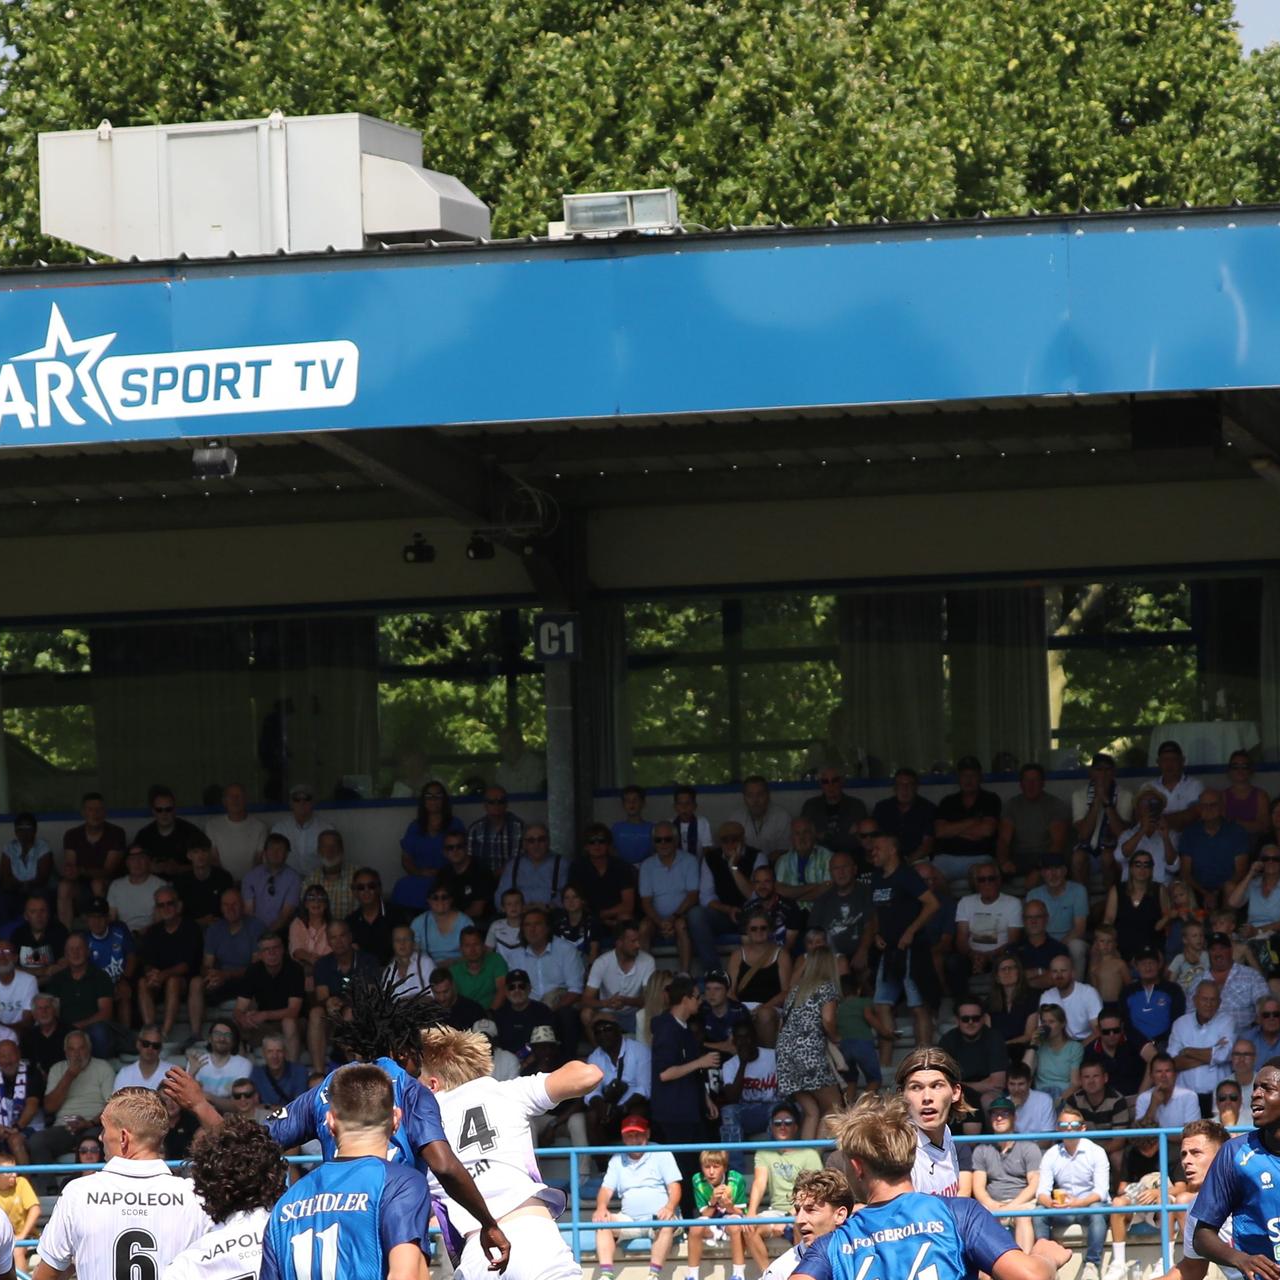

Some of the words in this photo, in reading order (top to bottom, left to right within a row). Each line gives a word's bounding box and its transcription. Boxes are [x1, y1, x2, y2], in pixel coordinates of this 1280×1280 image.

[120, 358, 272, 408] SPORT
[295, 357, 344, 392] TV
[539, 621, 576, 657] C1
[456, 1102, 500, 1154] 4
[86, 1191, 184, 1207] NAPOLEON
[121, 1208, 149, 1217] SCORE
